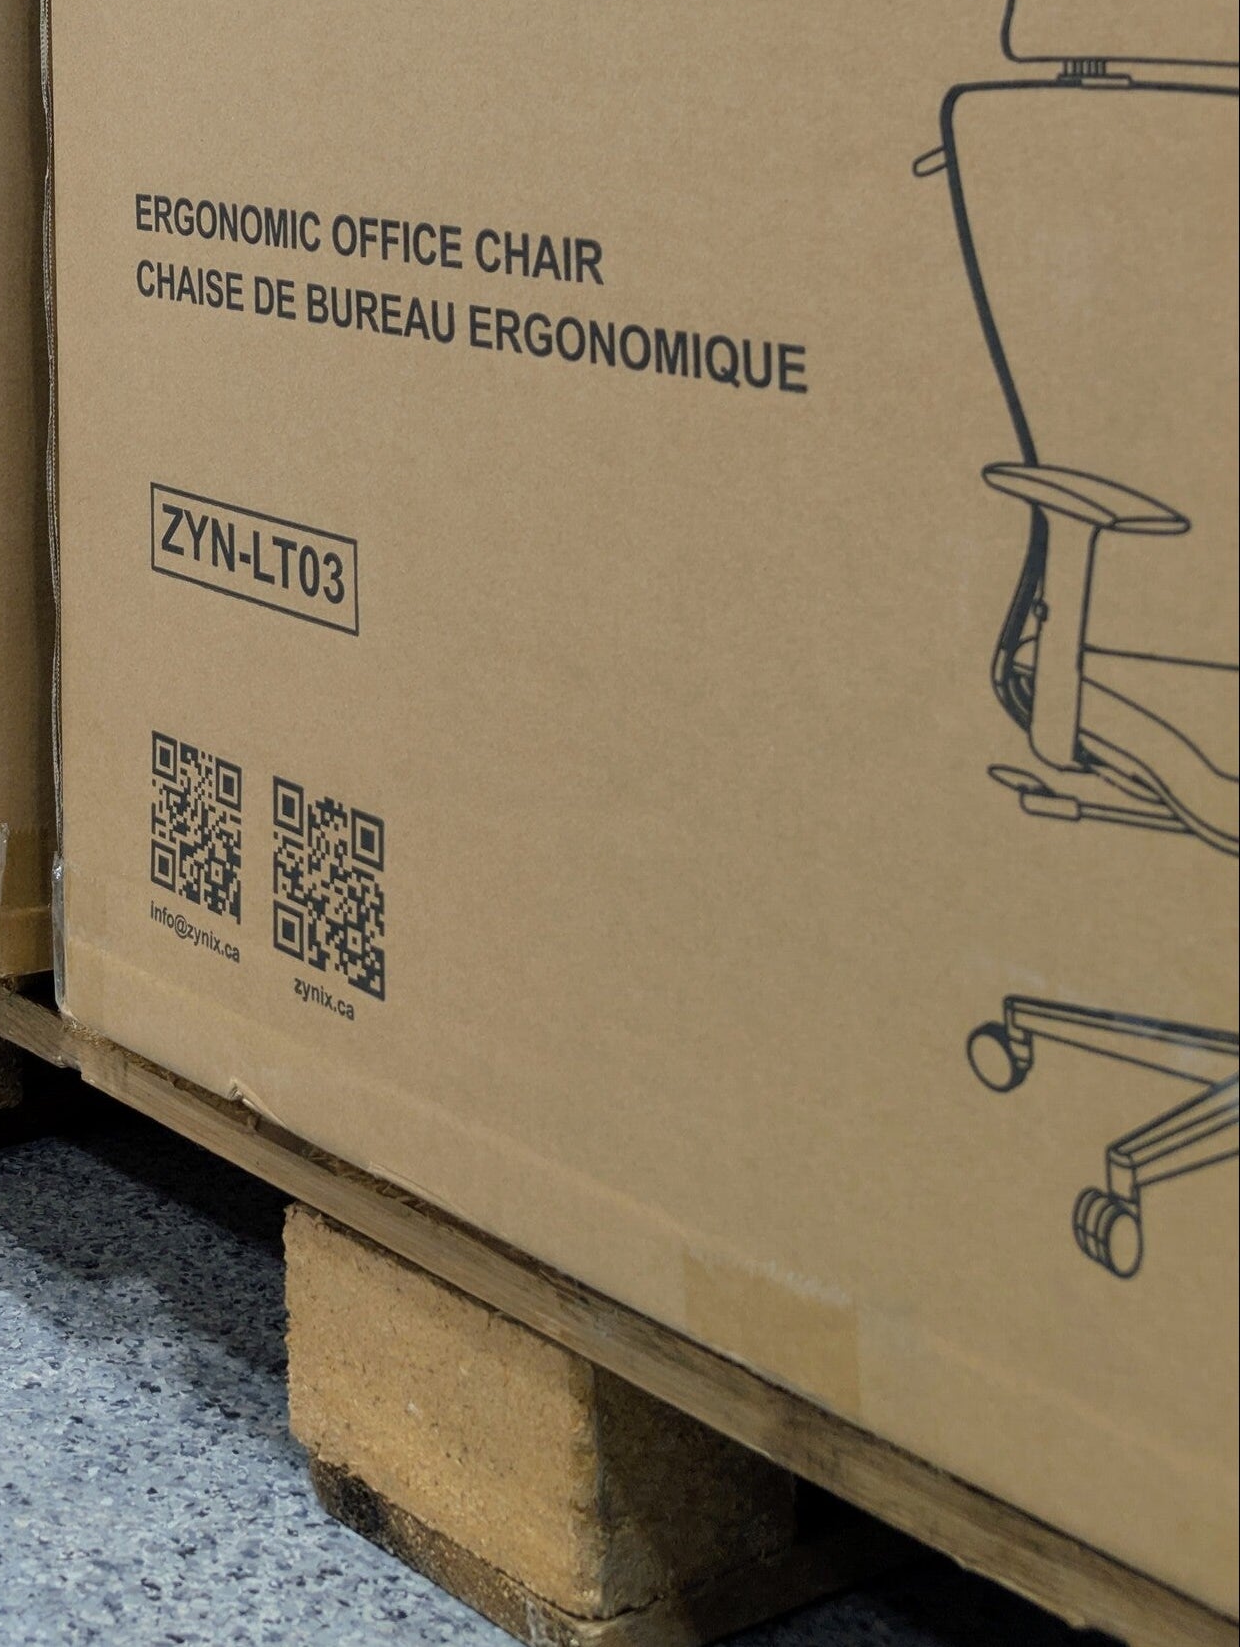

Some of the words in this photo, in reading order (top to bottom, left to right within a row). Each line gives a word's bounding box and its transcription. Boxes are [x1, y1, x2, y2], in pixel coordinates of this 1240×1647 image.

[136, 194, 320, 252] ERGONOMIC
[332, 215, 462, 269] OFFICE
[475, 229, 604, 285] CHAIR
[136, 260, 244, 311] CHAISE
[254, 277, 296, 320] DE
[307, 283, 455, 343] BUREAU
[469, 305, 808, 393] ERGONOMIQUE
[162, 503, 345, 605] ZYN-LT03
[150, 901, 241, 964] info@zynix.ca
[294, 978, 354, 1021] zynix.ca
